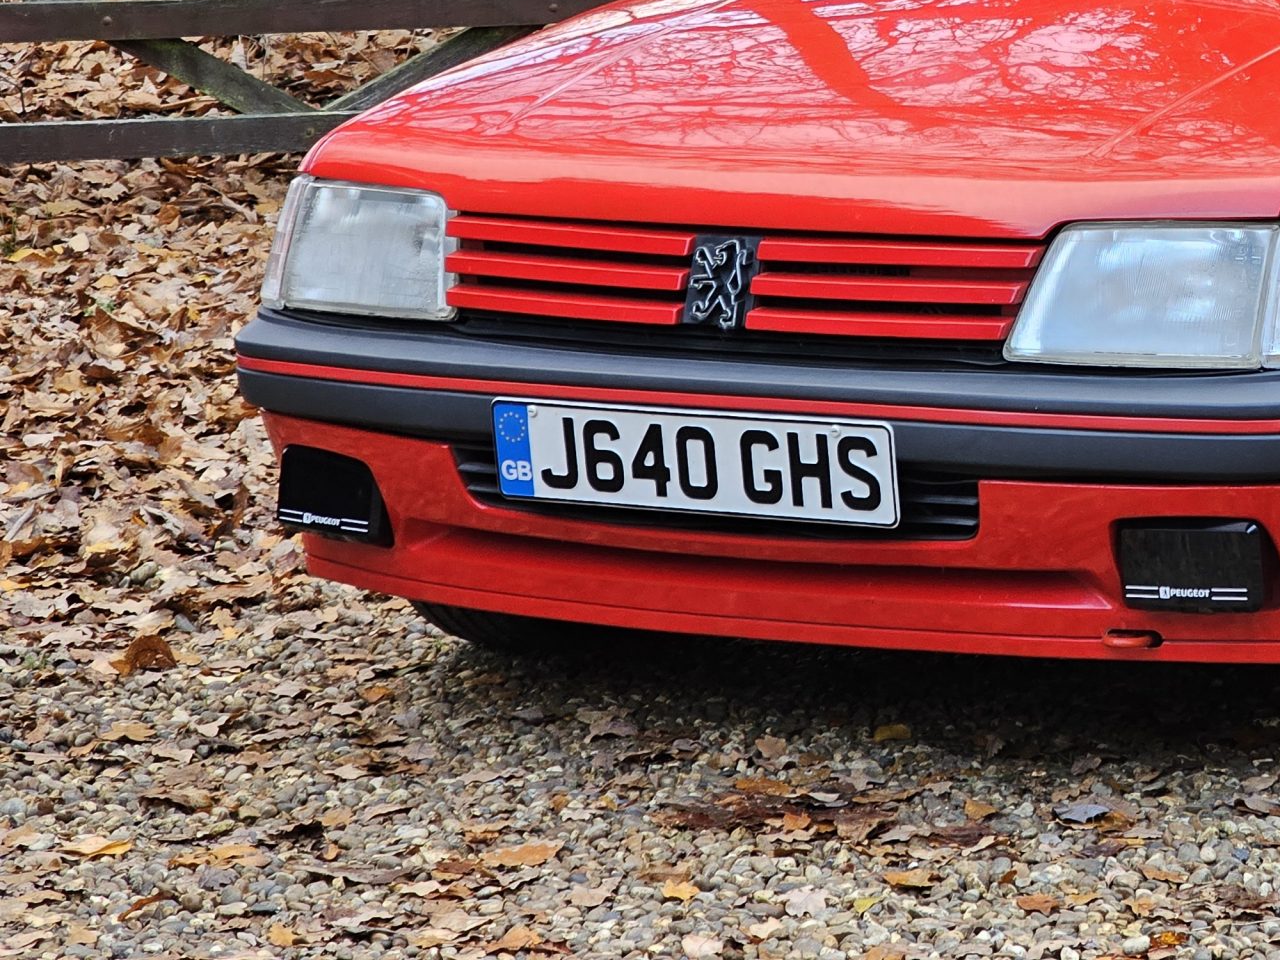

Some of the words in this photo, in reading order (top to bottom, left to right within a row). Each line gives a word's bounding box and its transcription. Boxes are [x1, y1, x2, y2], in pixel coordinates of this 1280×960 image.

[501, 460, 532, 482] GB
[541, 417, 719, 501] J640
[739, 429, 882, 512] GHS
[310, 514, 341, 526] PEUGEOT
[1170, 588, 1211, 598] PEUGEOT
